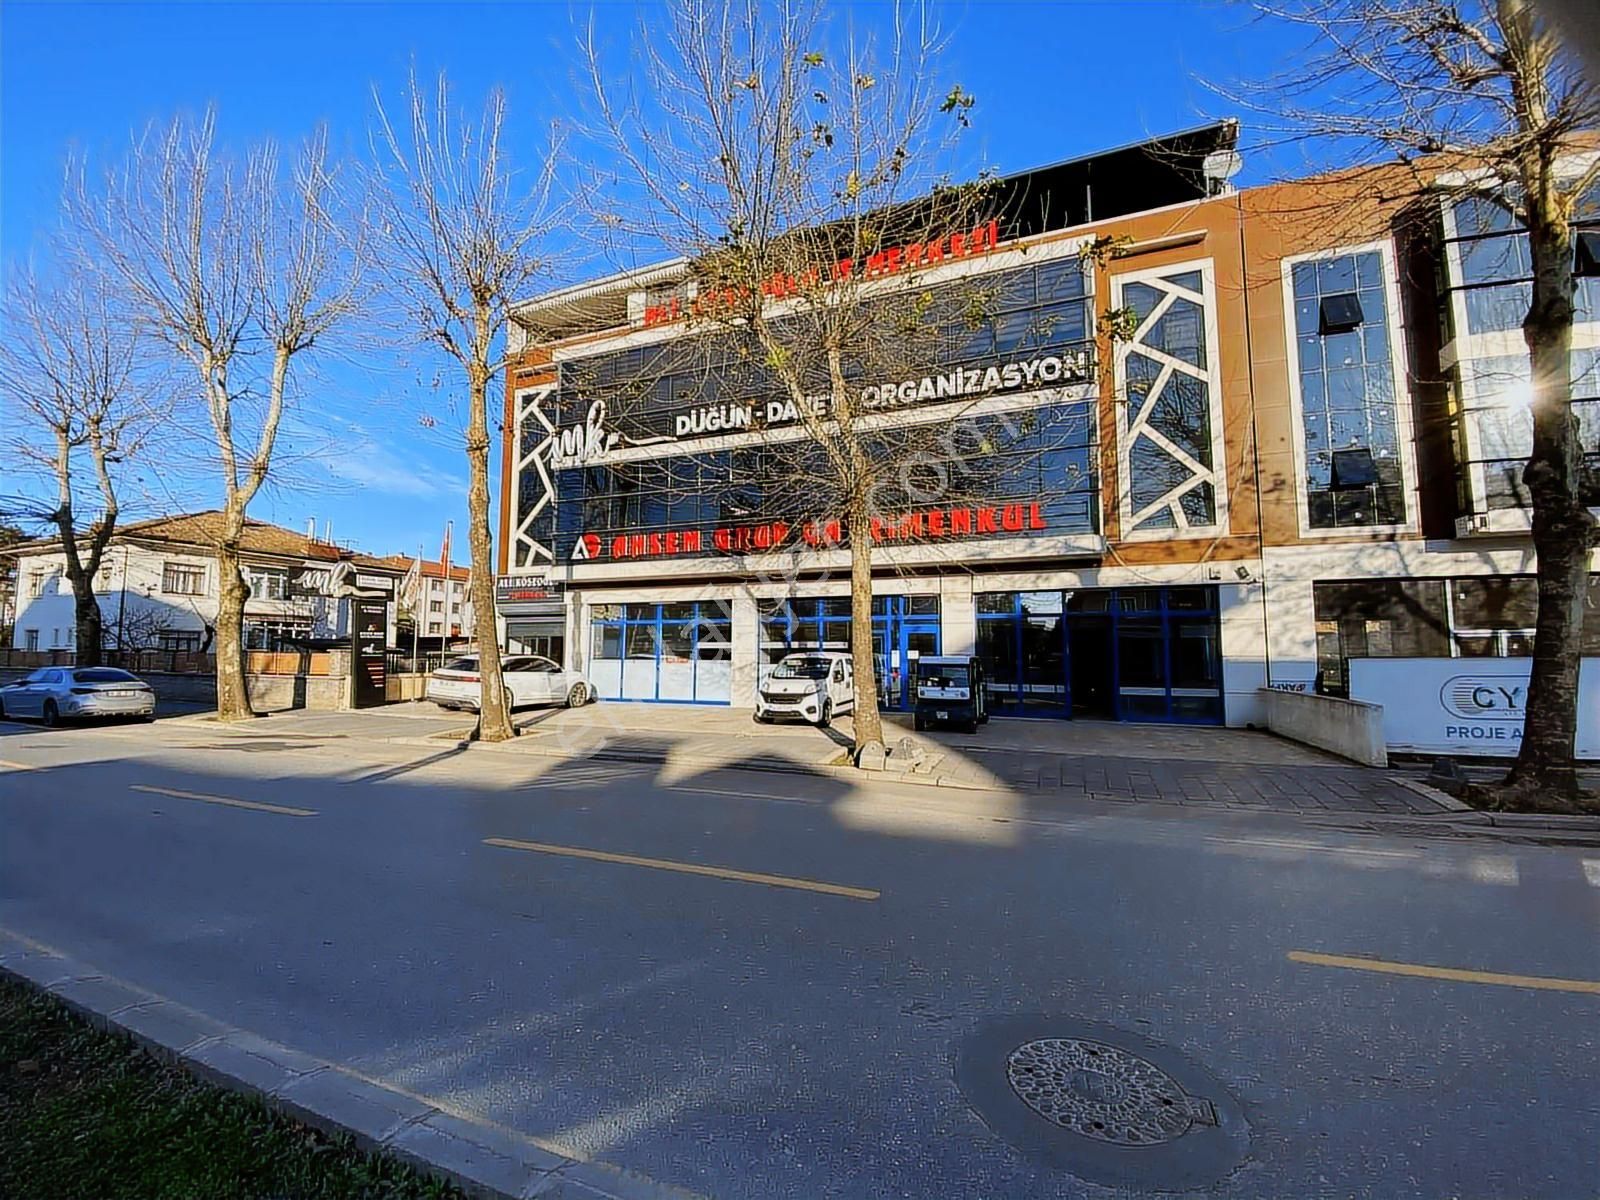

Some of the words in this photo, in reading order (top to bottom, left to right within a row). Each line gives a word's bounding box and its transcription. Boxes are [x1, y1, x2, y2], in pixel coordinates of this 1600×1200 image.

[676, 403, 752, 436] DÜĞÜN
[861, 351, 1086, 407] ORGANİZASYON
[1446, 726, 1506, 739] PROJE
